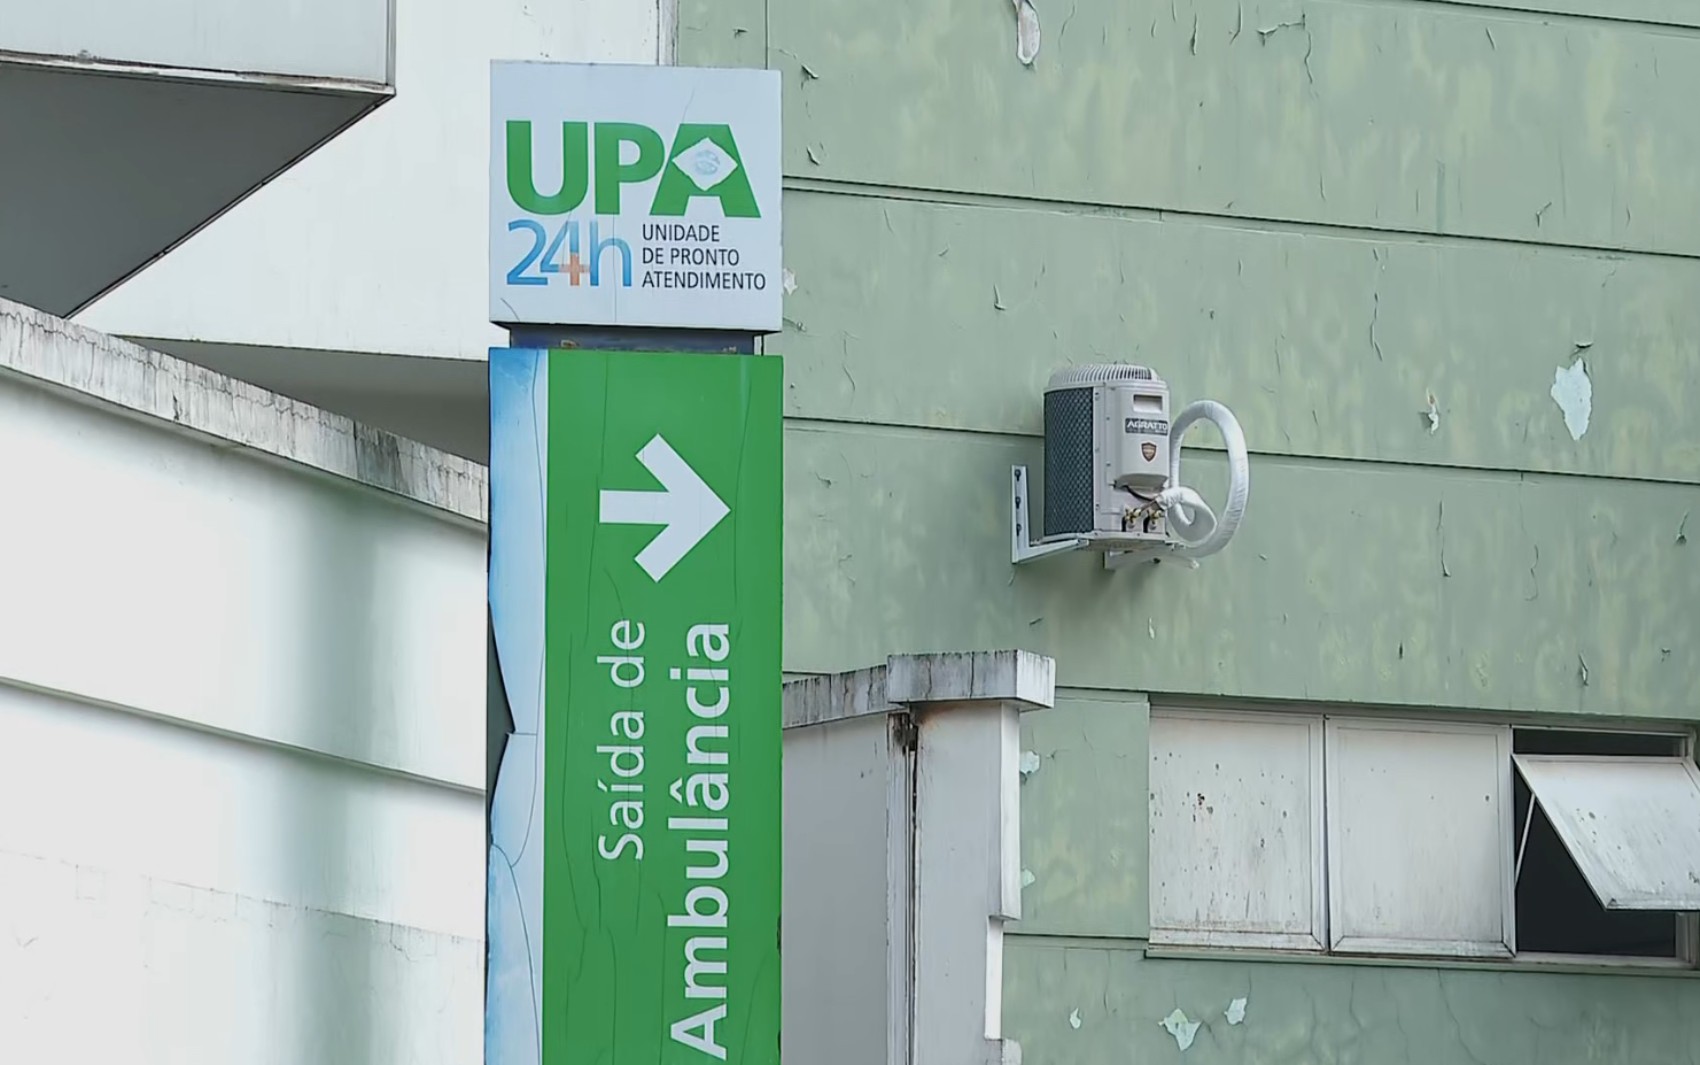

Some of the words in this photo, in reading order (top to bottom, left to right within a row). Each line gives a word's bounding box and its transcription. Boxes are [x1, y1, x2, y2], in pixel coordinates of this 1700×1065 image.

[506, 120, 762, 218] UPA
[506, 218, 632, 287] 24h
[642, 223, 720, 243] UNIDADE
[642, 247, 664, 265] DE
[671, 247, 740, 266] PRONTO
[641, 271, 767, 291] ATENDIMENTO
[1127, 420, 1168, 430] AGRATTO
[596, 619, 646, 688] de
[596, 710, 646, 861] Saída
[667, 622, 731, 1061] Ambulância
